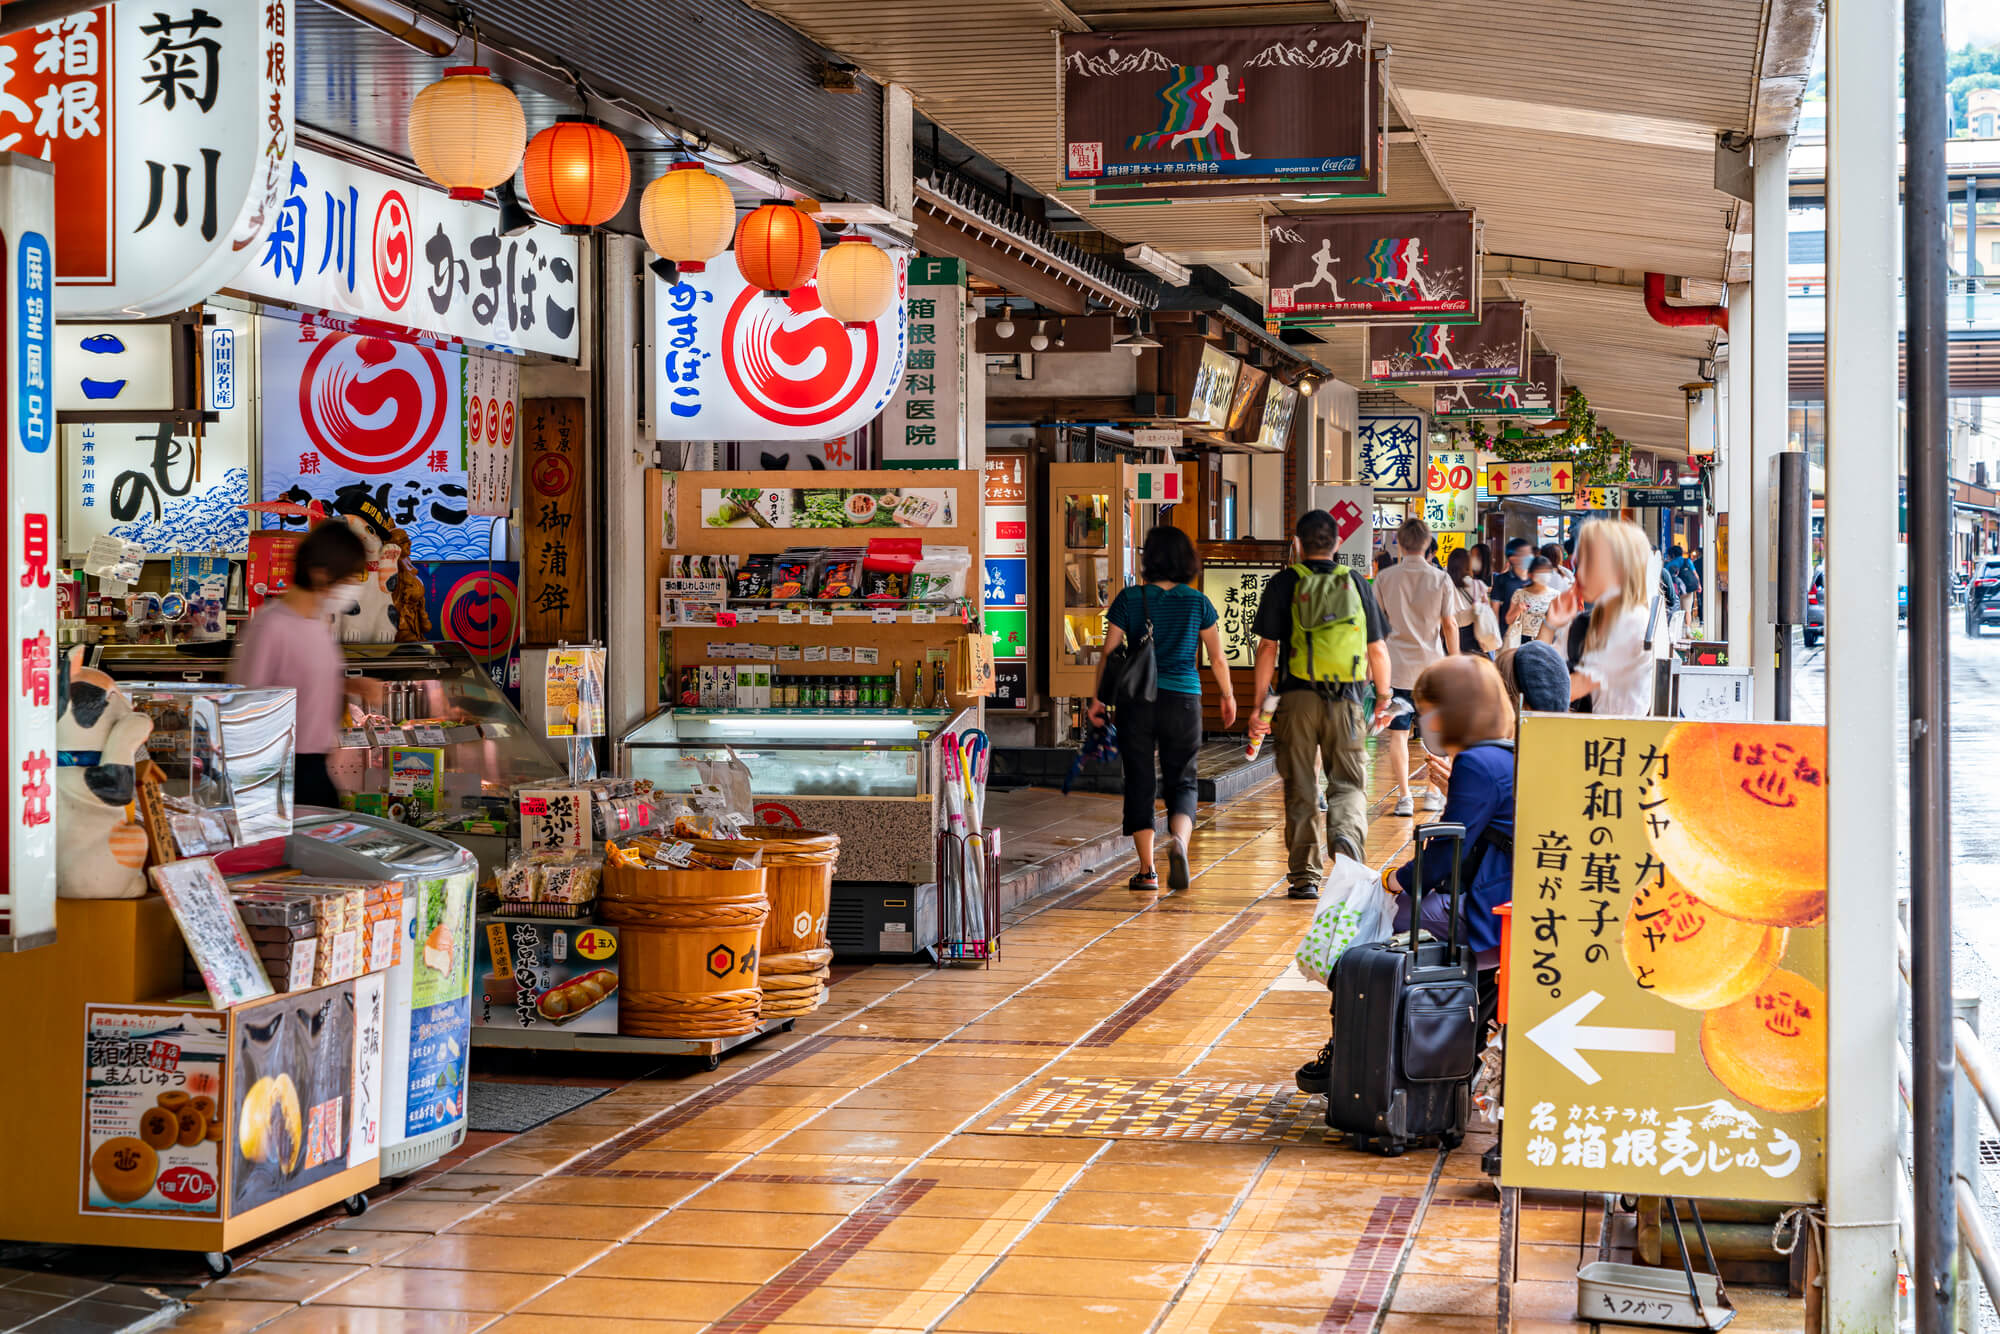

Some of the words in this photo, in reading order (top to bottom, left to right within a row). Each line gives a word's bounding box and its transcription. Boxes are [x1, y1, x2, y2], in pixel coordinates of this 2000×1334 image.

[34, 11, 100, 139] 箱根
[133, 8, 222, 241] 菊川
[424, 221, 576, 339] かまぼこ
[927, 262, 942, 281] F
[214, 332, 233, 405] 小田原名産
[664, 280, 714, 418] かまぼこ
[905, 298, 937, 446] 箱根歯科医院
[81, 420, 96, 508] 山市湯川商店
[298, 451, 321, 476] 録
[427, 450, 449, 473] 標
[531, 415, 549, 452] 名産
[556, 415, 573, 452] 小田原
[533, 501, 572, 625] 御蒲鉾
[1224, 587, 1241, 661] まんじゅう
[20, 512, 52, 829] 見晴荘
[1732, 741, 1822, 787] はこね
[1578, 736, 1626, 964] 昭和の菓子の
[1530, 830, 1573, 999] 音がする。
[1754, 991, 1812, 1020] はこね
[92, 1040, 150, 1067] 箱根
[104, 1066, 187, 1087] まんじゅう
[1561, 1115, 1801, 1179] 箱根まんじゅう
[1567, 1104, 1662, 1128] カステラ焼
[159, 1174, 213, 1195] 1個70円
